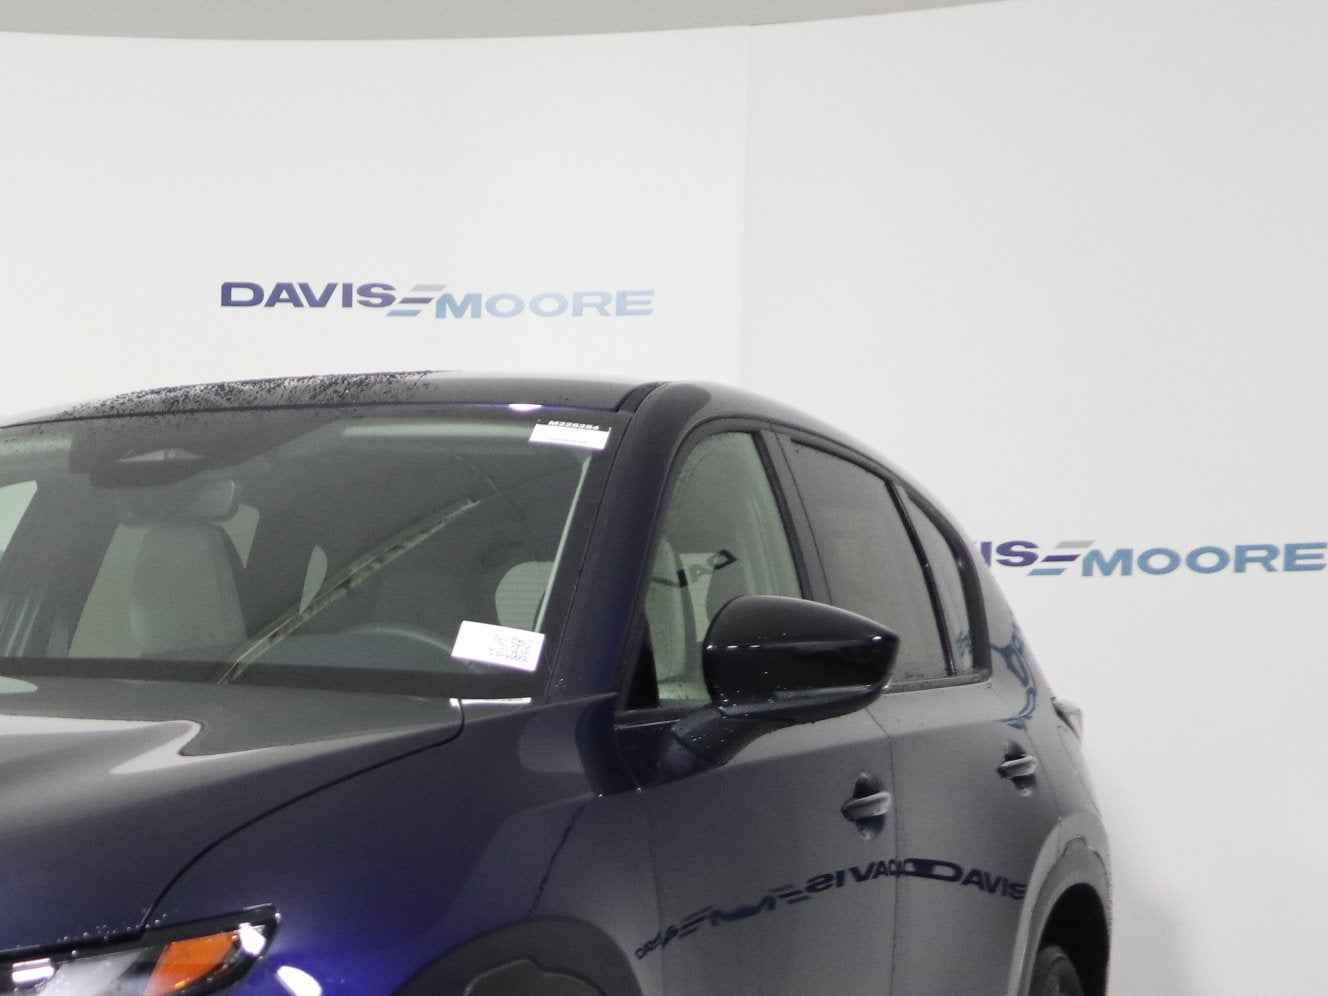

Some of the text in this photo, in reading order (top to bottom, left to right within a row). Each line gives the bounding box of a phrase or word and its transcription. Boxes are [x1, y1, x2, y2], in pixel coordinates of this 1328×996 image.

[220, 282, 655, 319] DAVIS MOORE
[1081, 541, 1327, 577] MOORE
